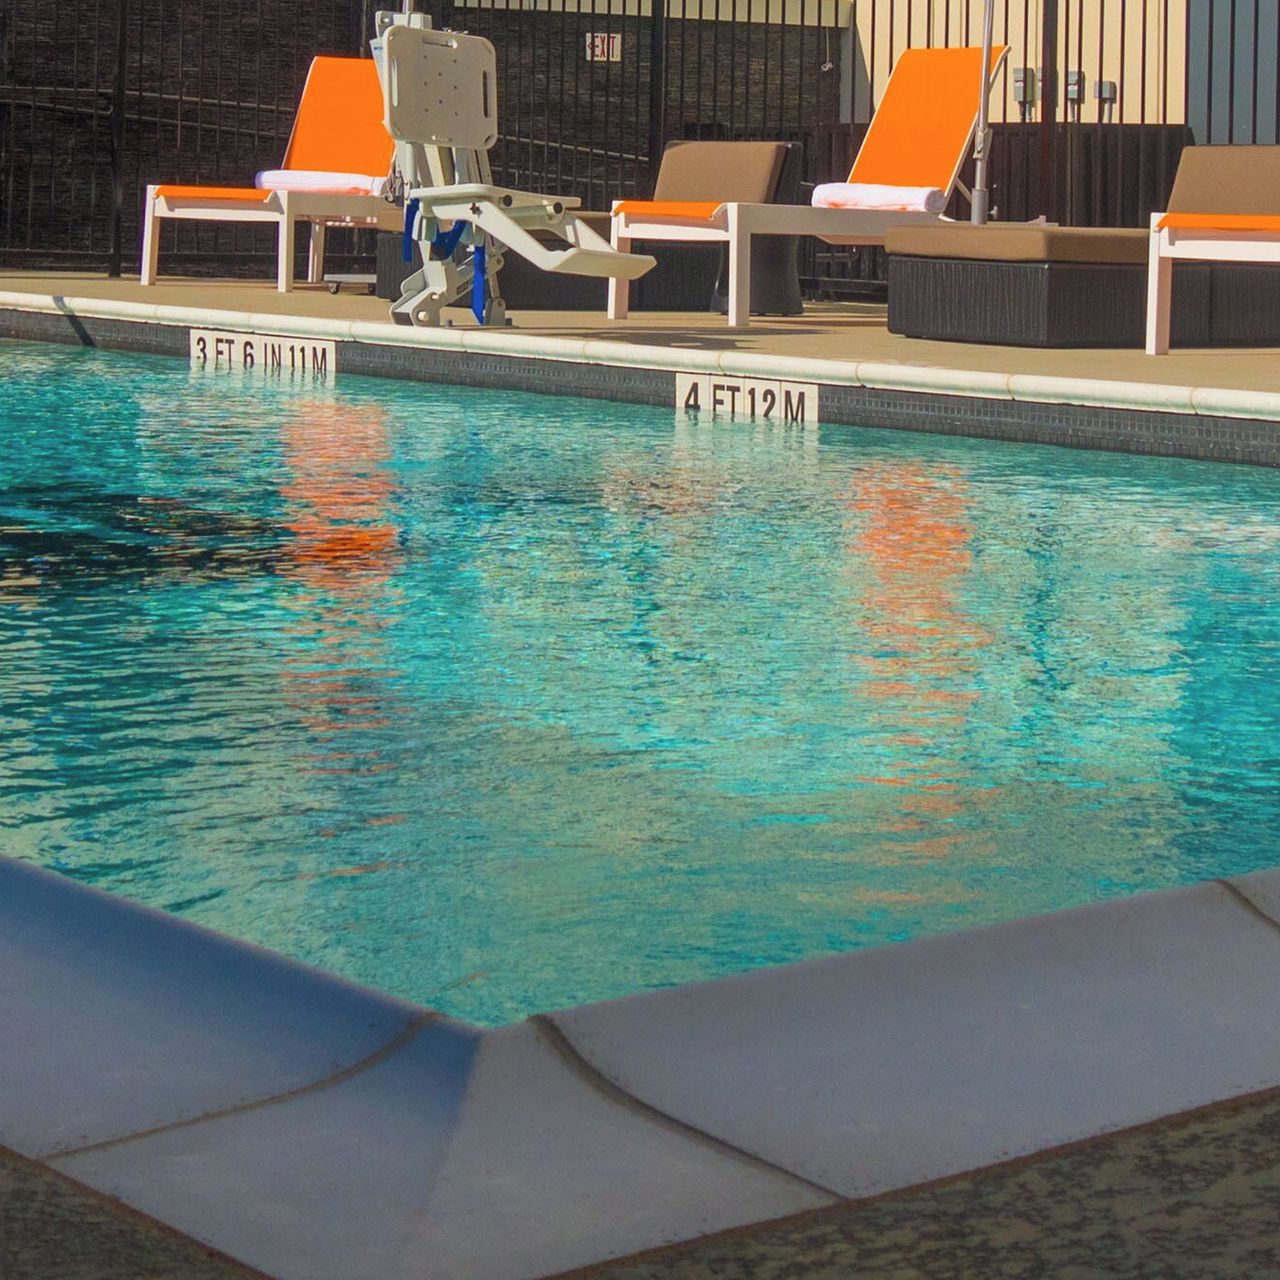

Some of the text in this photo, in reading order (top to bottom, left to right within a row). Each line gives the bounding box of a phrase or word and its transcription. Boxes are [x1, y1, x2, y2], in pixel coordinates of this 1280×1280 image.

[593, 35, 616, 58] EXT
[196, 336, 207, 361] 3
[214, 337, 235, 363] FT
[242, 340, 255, 365] 6
[263, 342, 281, 366] IN
[312, 346, 326, 369] M
[684, 381, 701, 410] 4
[712, 383, 741, 414] FT
[785, 390, 806, 421] M
